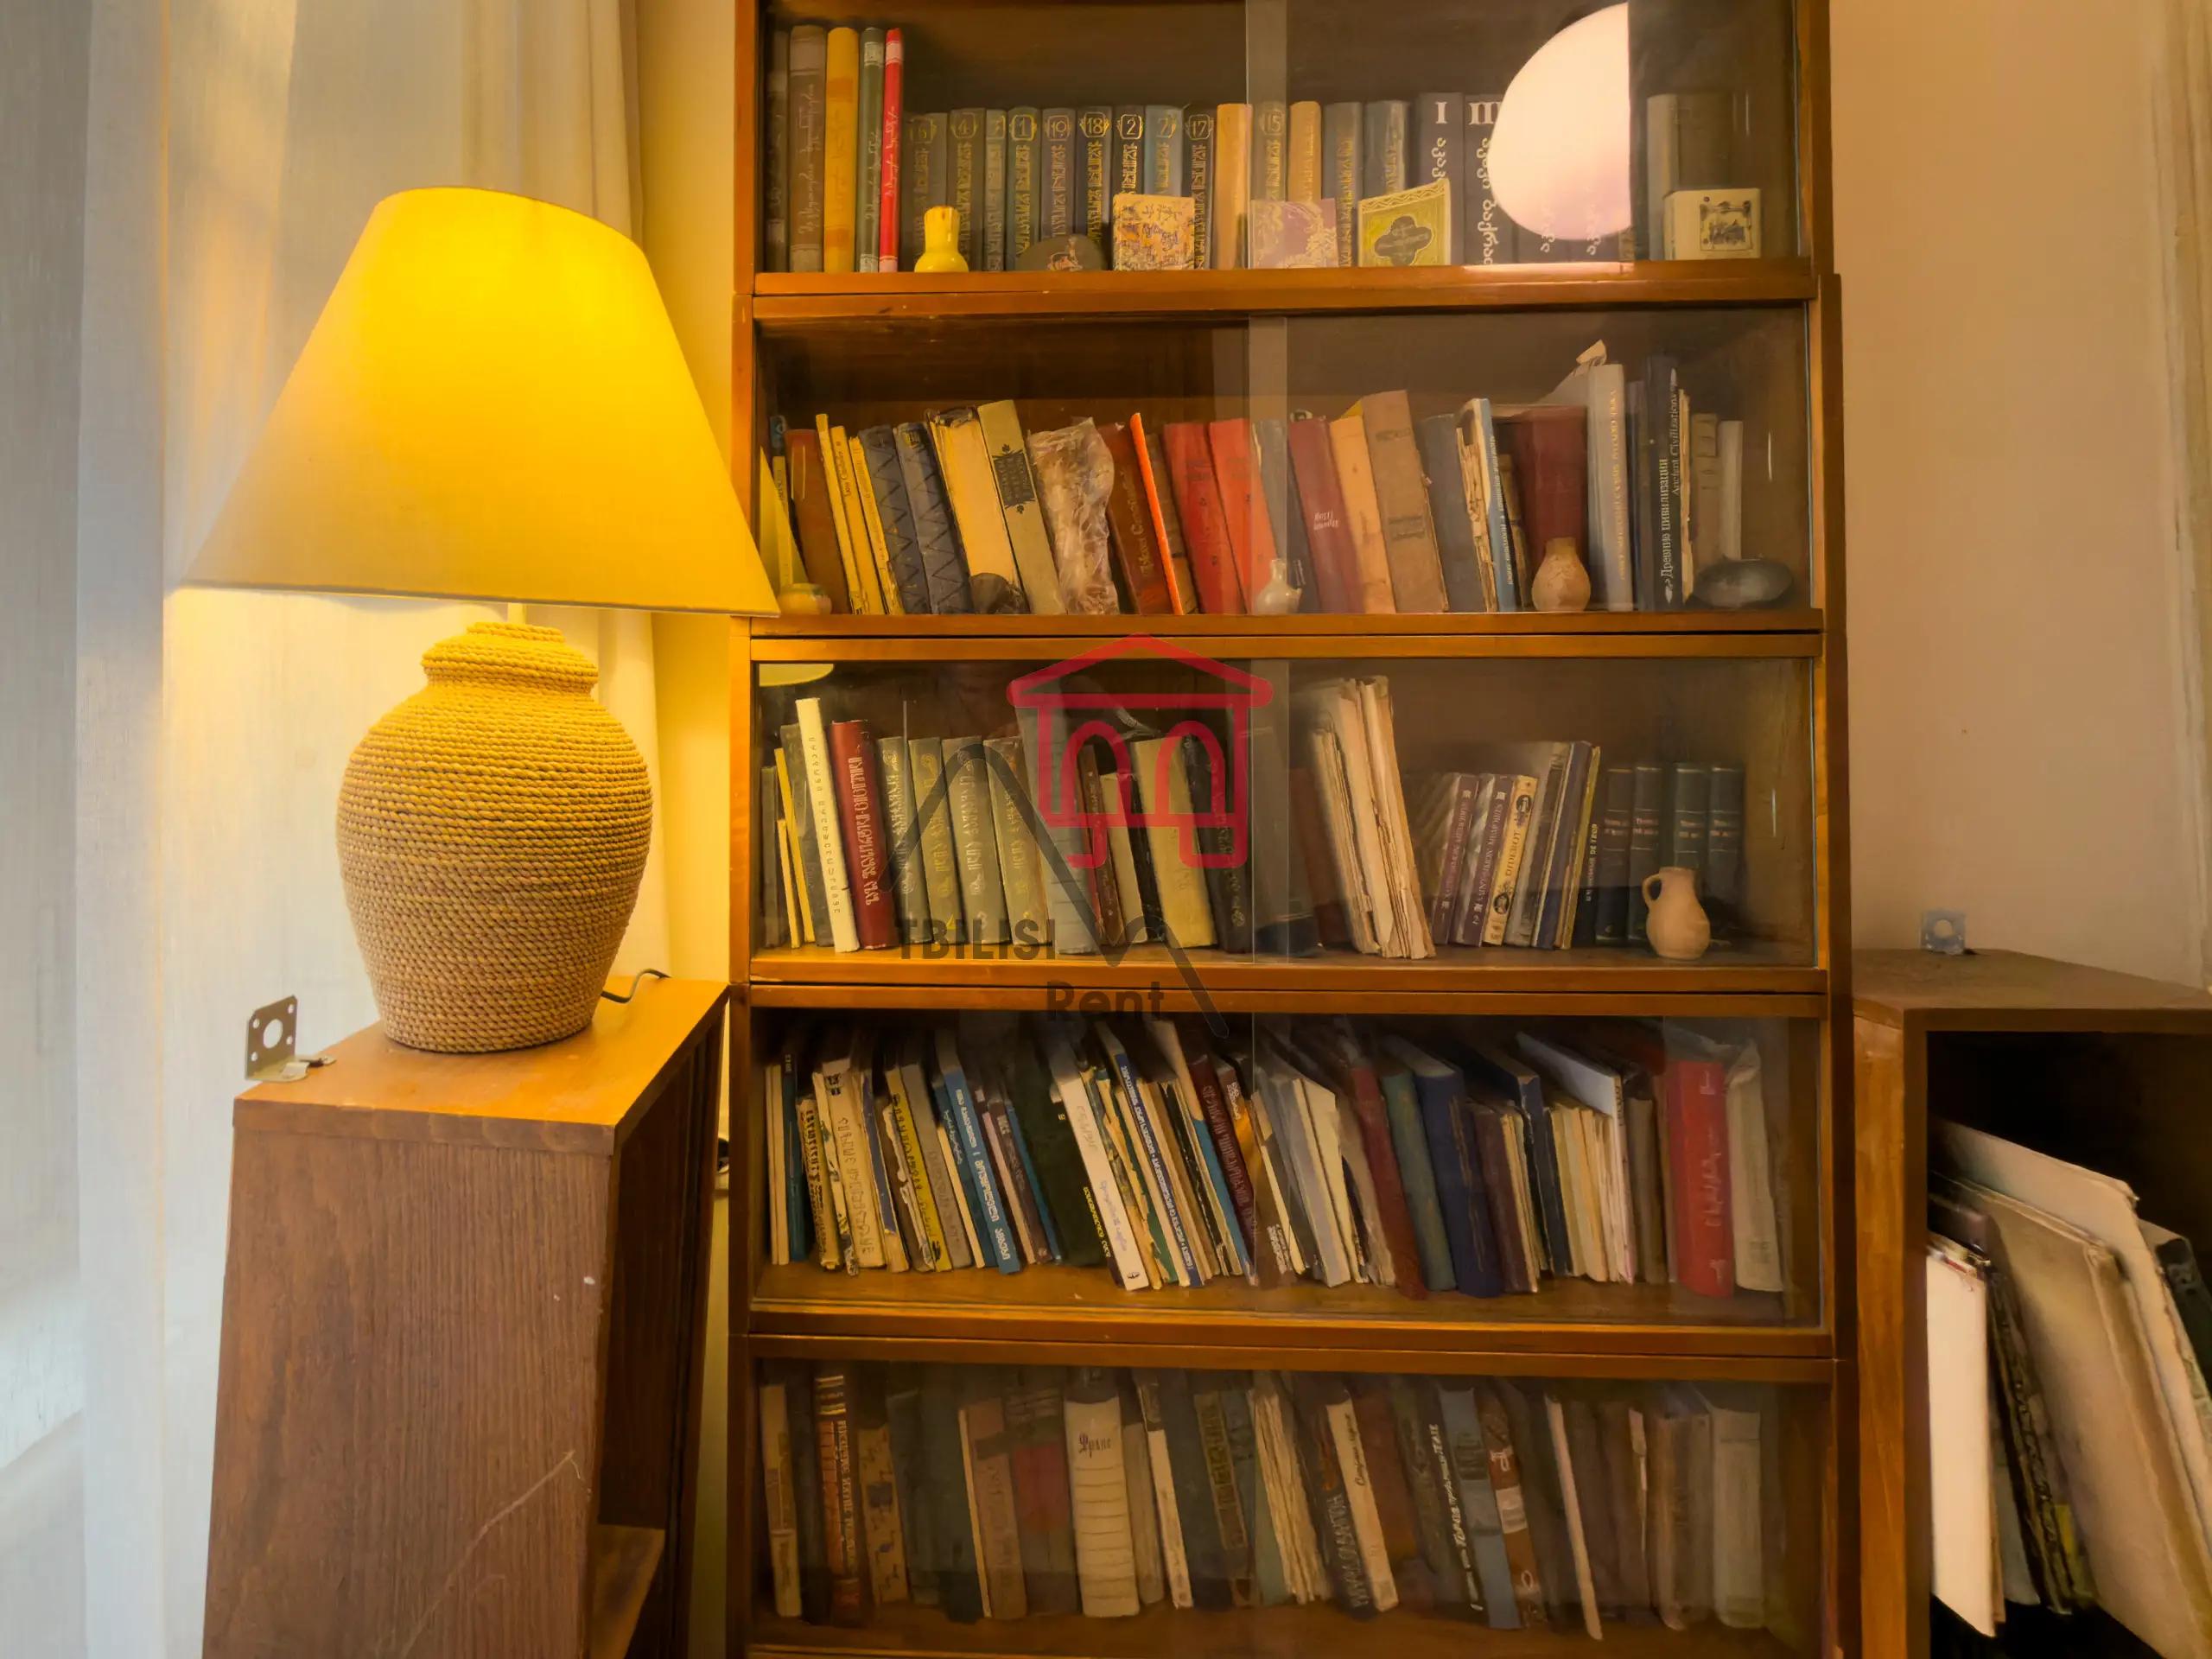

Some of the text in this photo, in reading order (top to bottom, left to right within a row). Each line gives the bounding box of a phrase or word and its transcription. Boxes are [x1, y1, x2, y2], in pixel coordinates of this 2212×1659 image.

[1086, 118, 1103, 134] 18
[1192, 120, 1207, 137] 17
[1434, 101, 1448, 124] I
[1468, 101, 1502, 125] II
[1431, 137, 1447, 179] აკაკ
[1478, 199, 1499, 265] ბაქრა
[1669, 392, 1681, 497] Ancient Civilizations
[1658, 458, 1671, 531] цивилизации
[1505, 830, 1522, 877] DIDEROT
